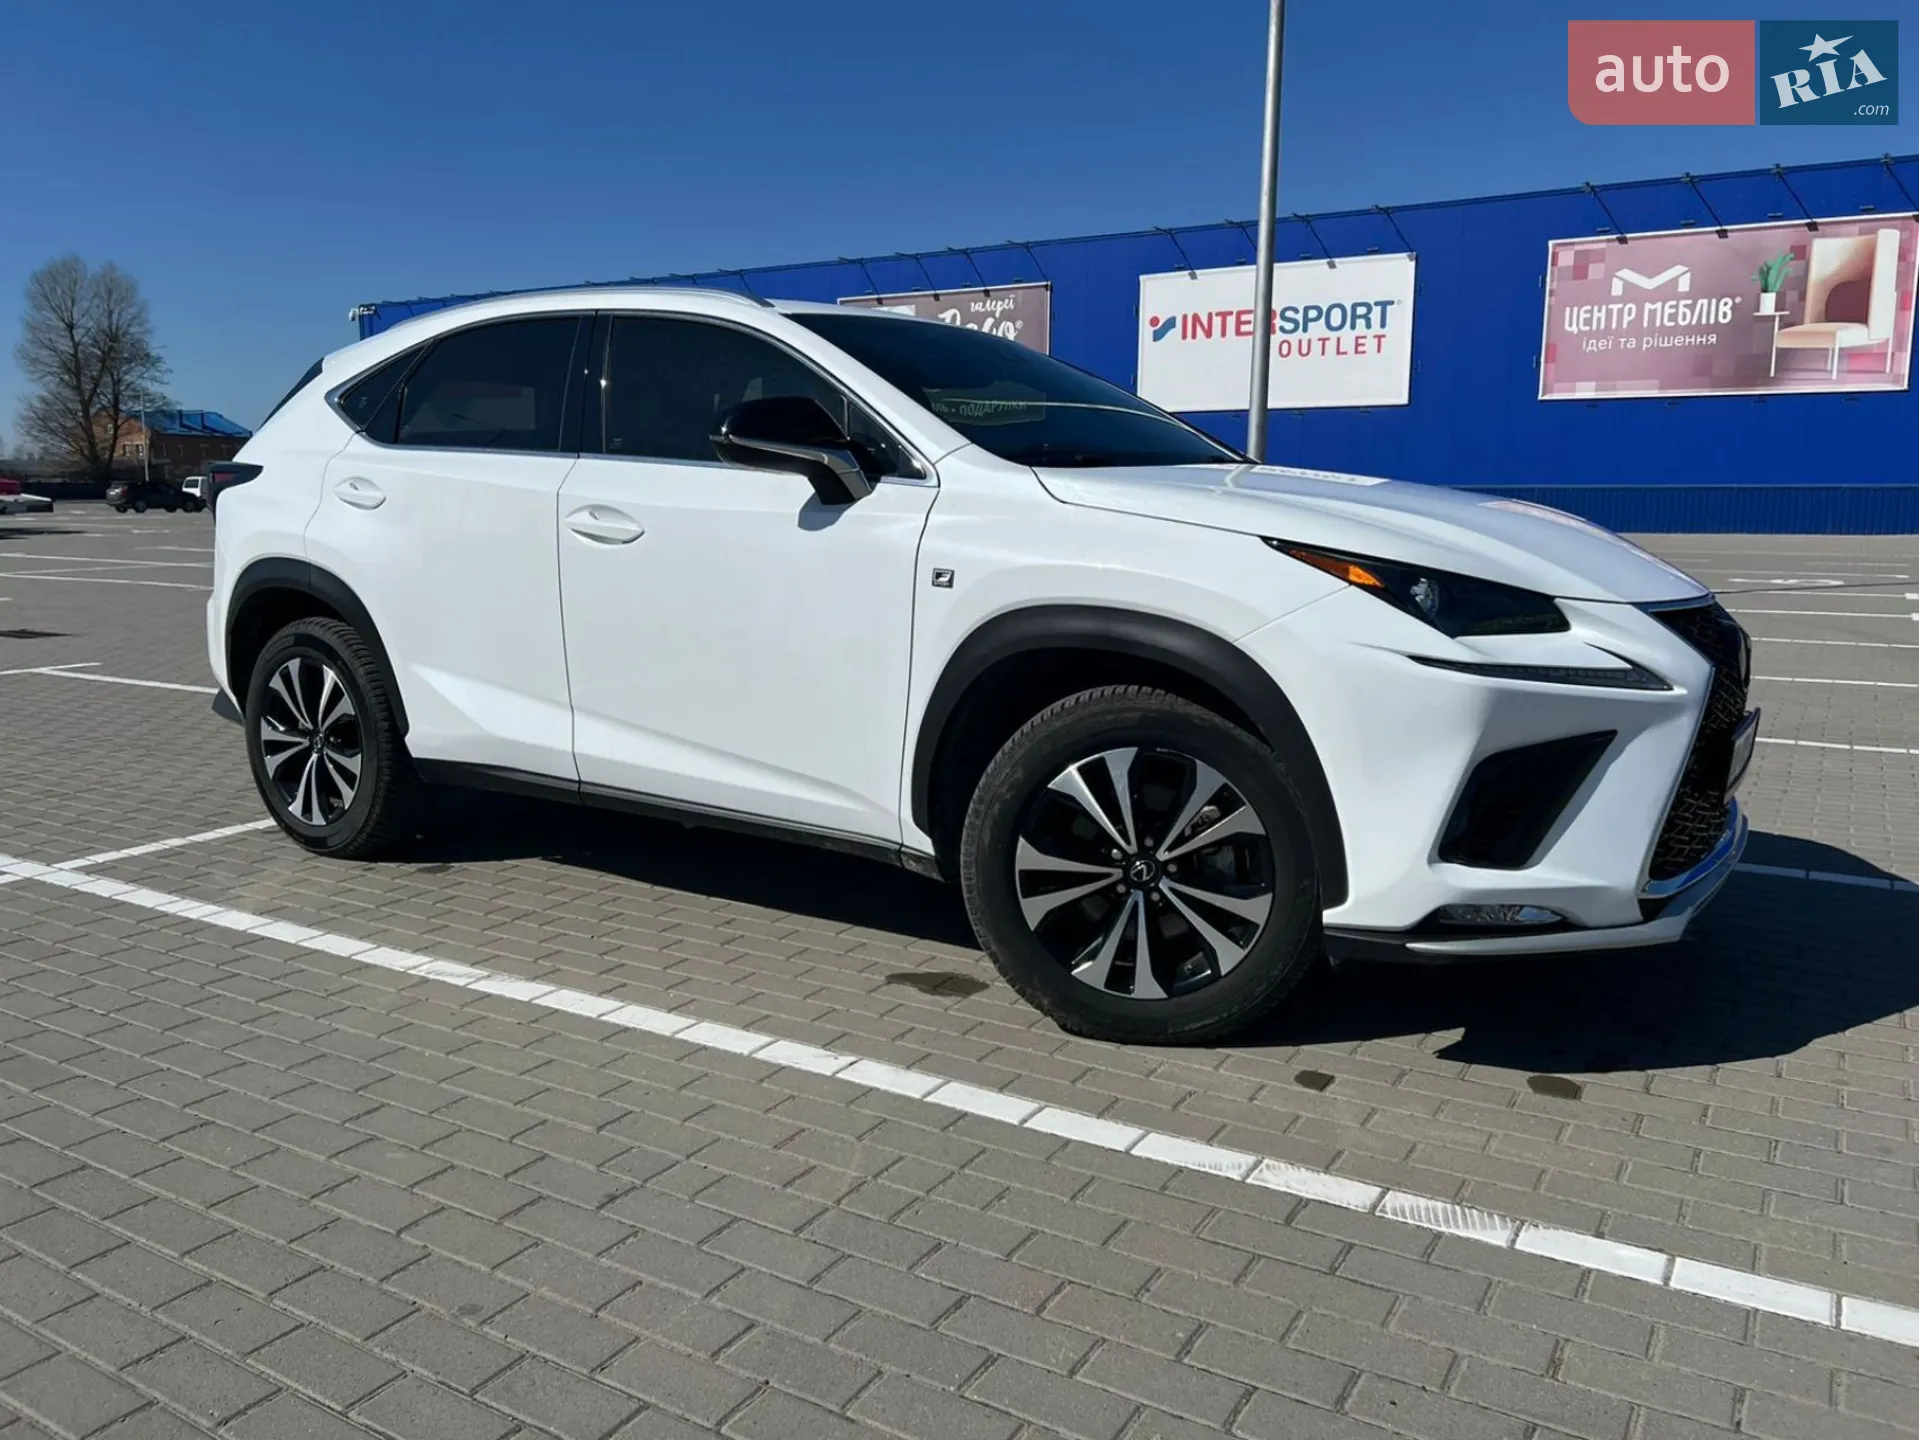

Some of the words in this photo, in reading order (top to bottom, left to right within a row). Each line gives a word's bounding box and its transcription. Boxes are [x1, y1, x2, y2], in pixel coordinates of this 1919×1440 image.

[1563, 302, 1637, 334] ЦЕНТР
[1278, 334, 1387, 358] OUTLET
[1582, 337, 1614, 353] ідеї
[1619, 336, 1636, 349] та
[1642, 333, 1718, 351] рішення
